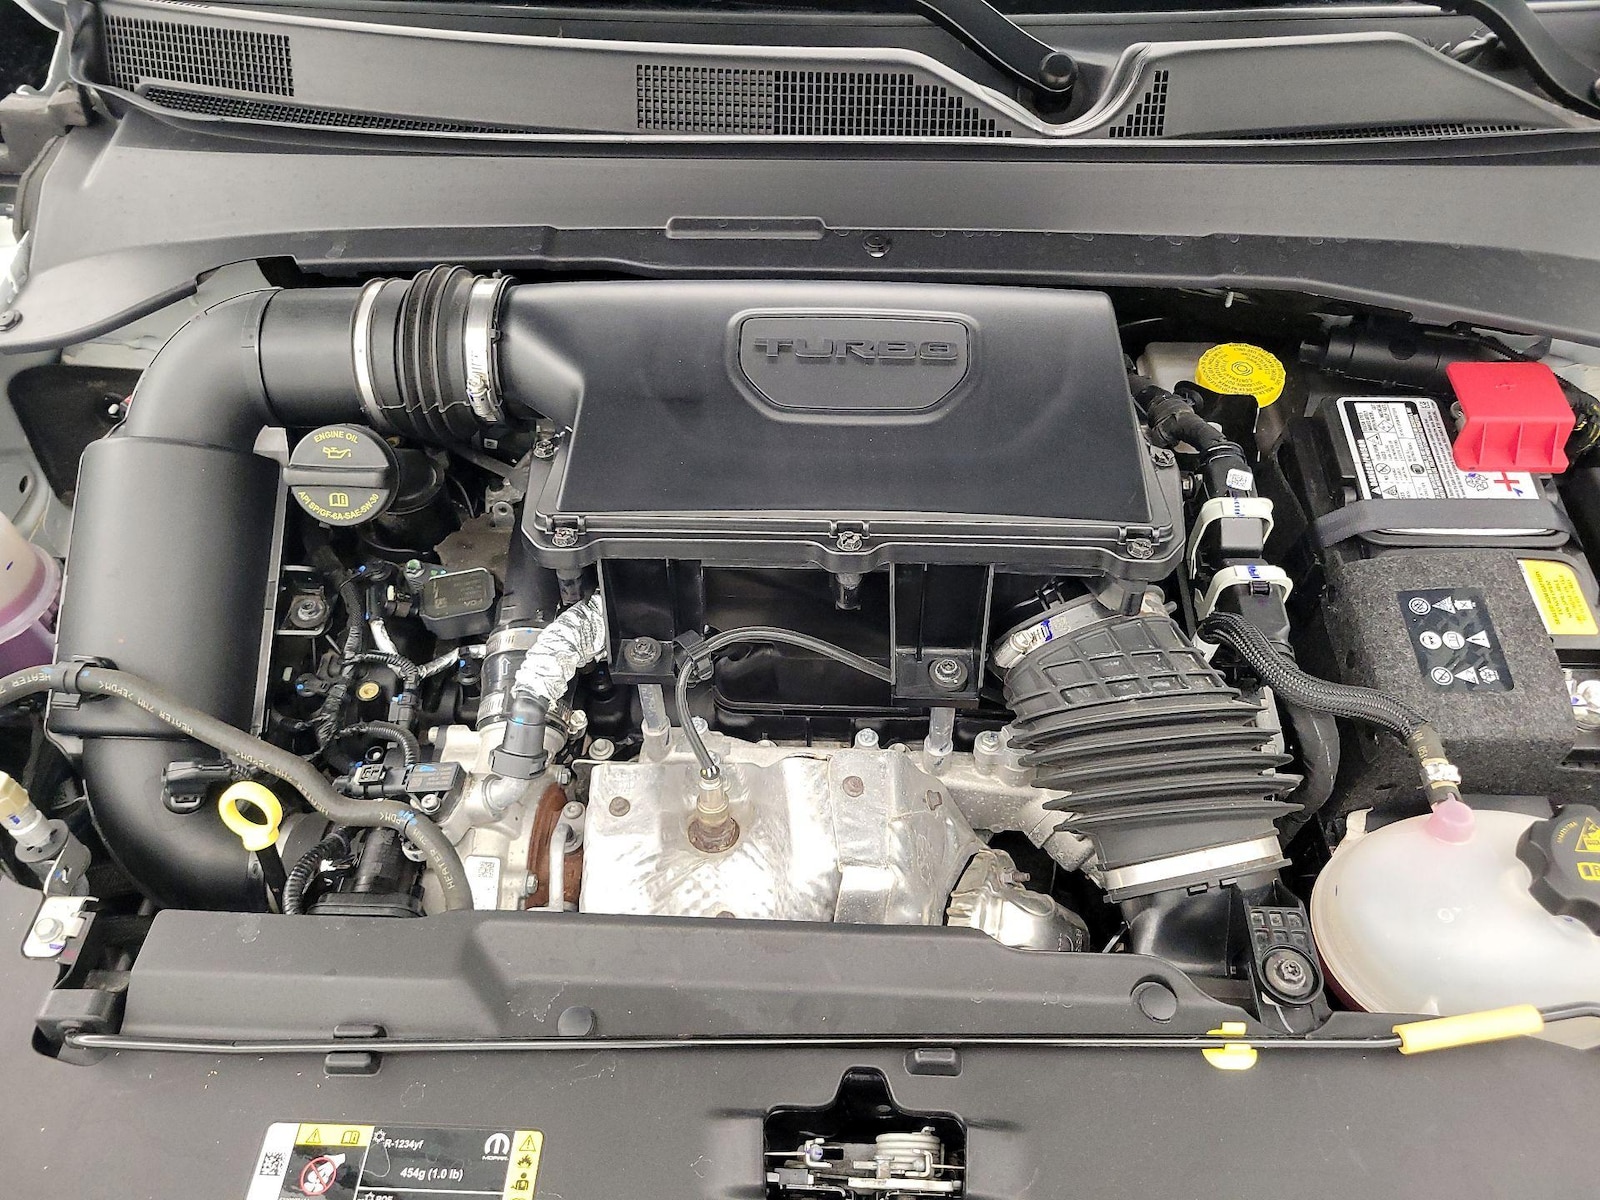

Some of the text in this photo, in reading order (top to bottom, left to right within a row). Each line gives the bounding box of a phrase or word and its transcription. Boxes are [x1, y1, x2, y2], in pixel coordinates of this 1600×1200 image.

[754, 338, 958, 361] TURBO
[314, 431, 358, 444] ENGINE OIL
[298, 491, 311, 505] API
[12, 672, 52, 688] HEATER
[159, 710, 194, 734] HEATER
[429, 848, 456, 891] HEATER
[384, 1138, 424, 1151] R-1234yf
[400, 1167, 465, 1182] 454g (1.0 lb)
